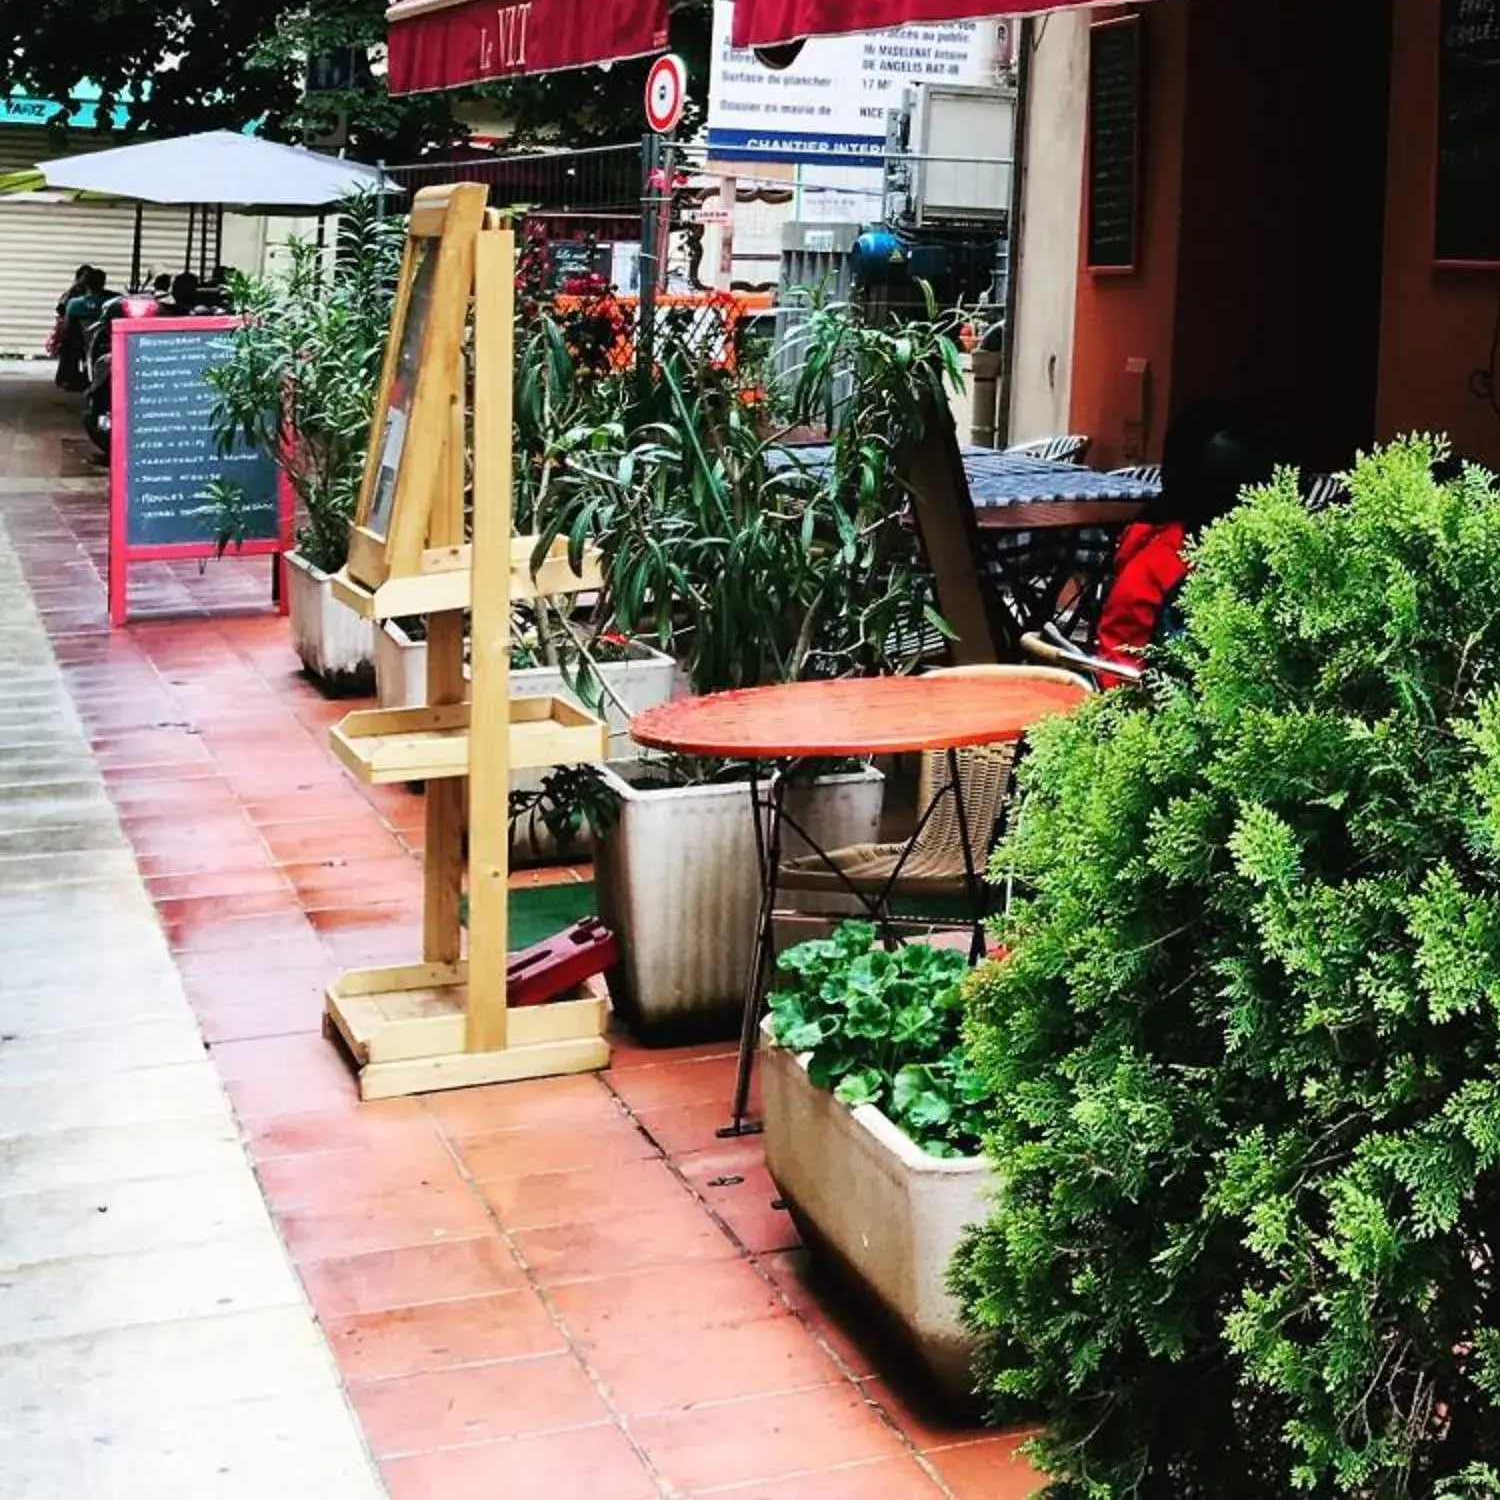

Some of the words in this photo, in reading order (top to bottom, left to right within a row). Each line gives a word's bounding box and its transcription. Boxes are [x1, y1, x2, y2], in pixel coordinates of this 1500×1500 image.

[722, 51, 757, 65] Entrep
[879, 59, 923, 73] ANGELIS
[722, 70, 764, 84] Surface
[767, 72, 781, 85] du
[783, 74, 832, 88] plancher
[720, 98, 761, 111] Dossier
[781, 102, 816, 115] mairie
[859, 106, 884, 118] NICE
[833, 141, 886, 156] INTER
